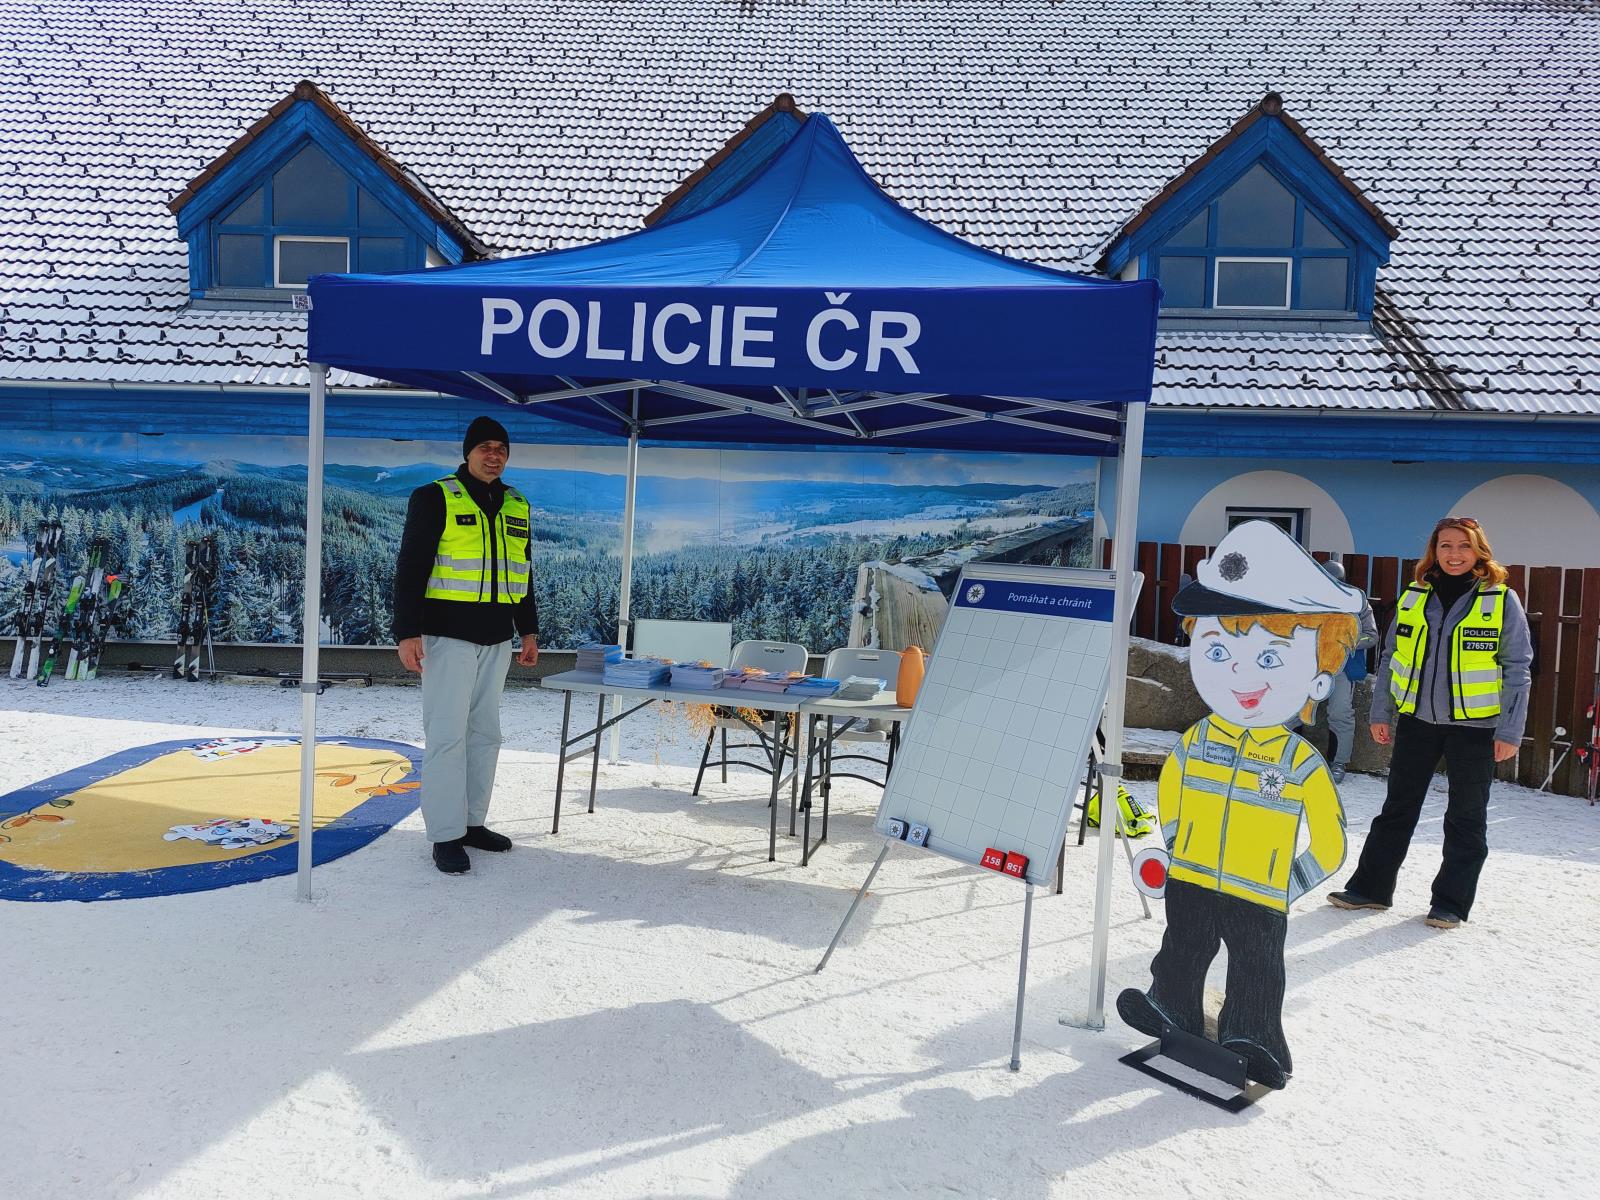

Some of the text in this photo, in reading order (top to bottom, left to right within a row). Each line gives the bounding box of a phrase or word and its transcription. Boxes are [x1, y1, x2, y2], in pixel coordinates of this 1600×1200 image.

[480, 291, 922, 375] POLICIE ČR
[1007, 592, 1048, 605] Pomáhat
[1057, 596, 1093, 609] chránit
[1466, 642, 1494, 650] 276575
[1248, 751, 1276, 762] POLICIE
[985, 856, 1001, 866] 158
